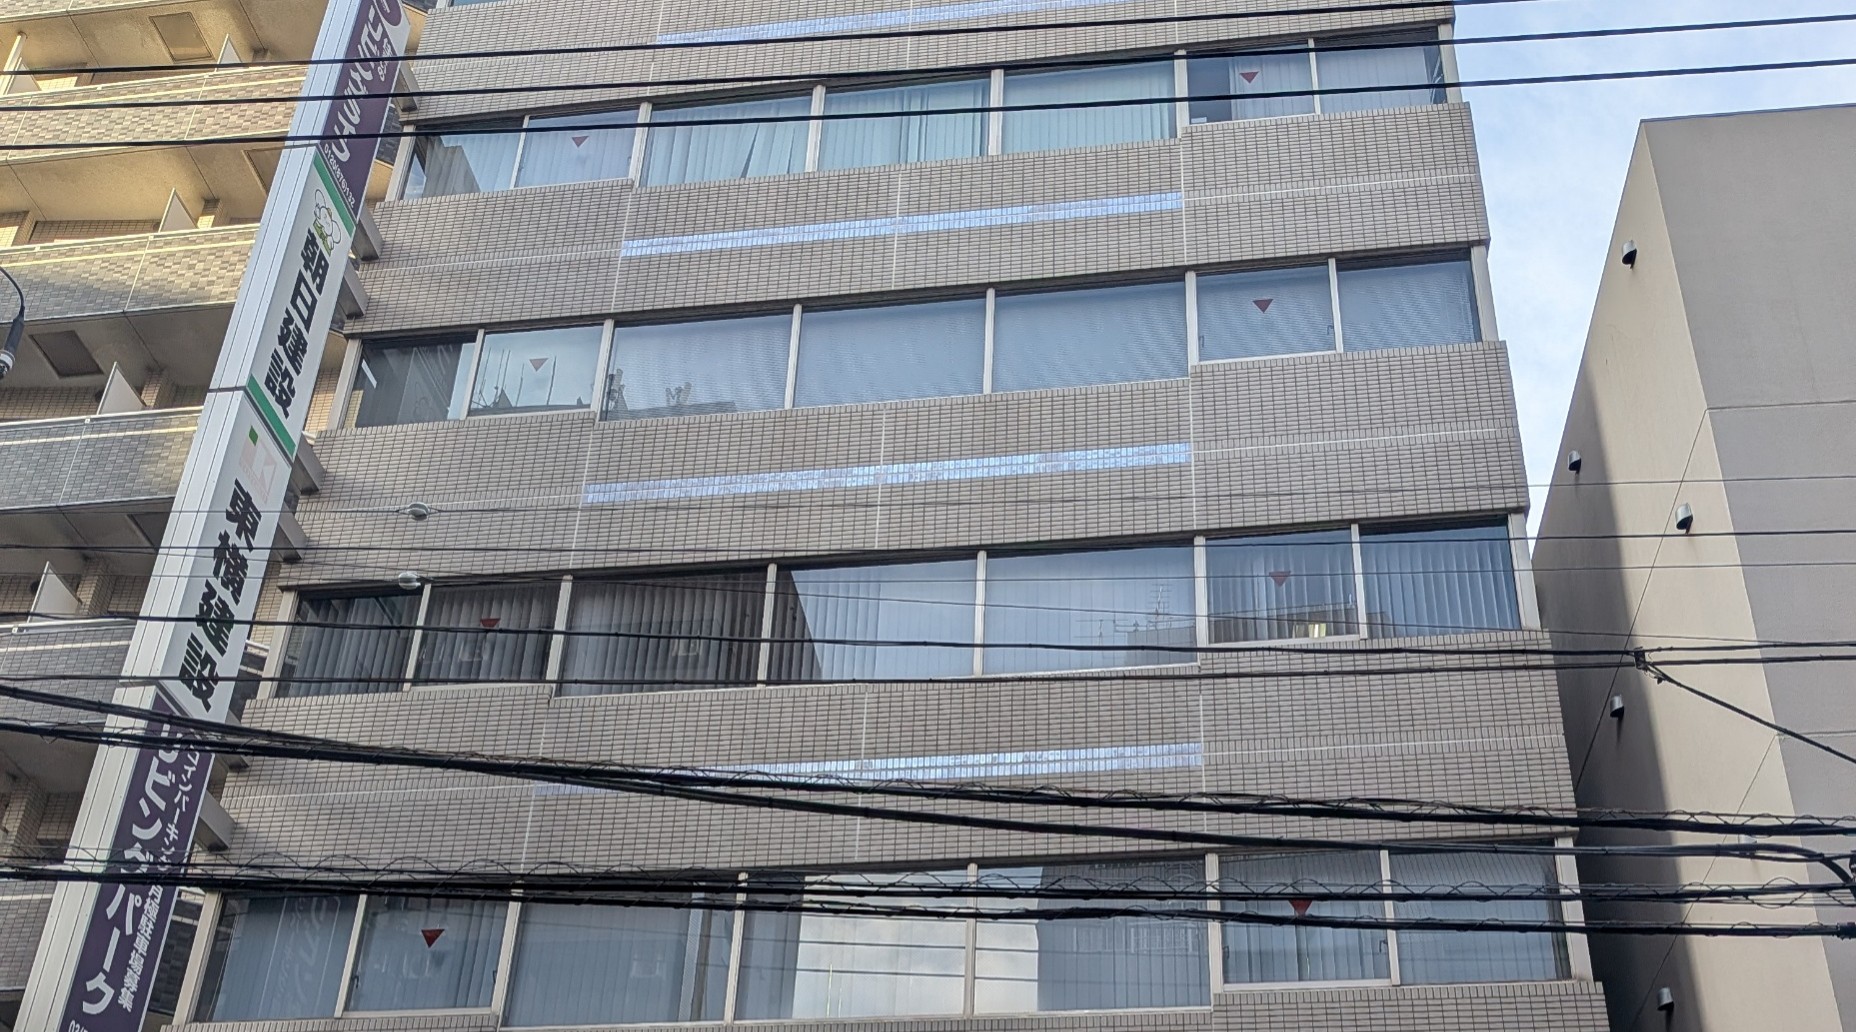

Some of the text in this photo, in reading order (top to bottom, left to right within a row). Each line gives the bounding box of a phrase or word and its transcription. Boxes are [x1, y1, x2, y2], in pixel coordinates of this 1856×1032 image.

[324, 143, 356, 208] 0120(876)132
[332, 5, 383, 163] リビングライフ
[264, 228, 330, 420] 朝日建設
[179, 478, 262, 713] 東横建設
[82, 722, 183, 1015] リビングパーク
